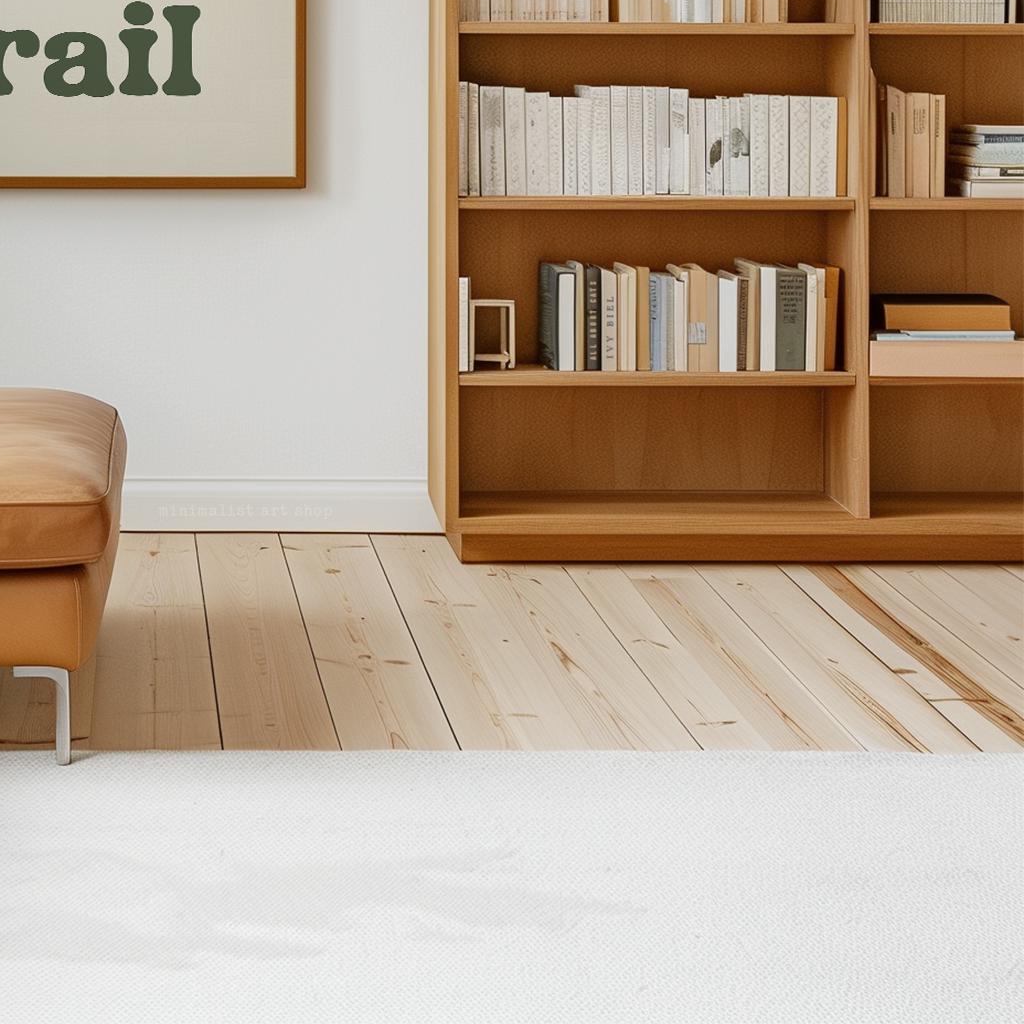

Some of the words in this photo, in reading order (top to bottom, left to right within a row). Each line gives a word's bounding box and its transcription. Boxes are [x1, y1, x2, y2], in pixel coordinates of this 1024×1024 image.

[589, 281, 597, 303] CATS
[606, 296, 615, 327] BIEL
[589, 310, 597, 338] ABOUT
[589, 344, 597, 361] ALL
[606, 336, 614, 359] IVY
